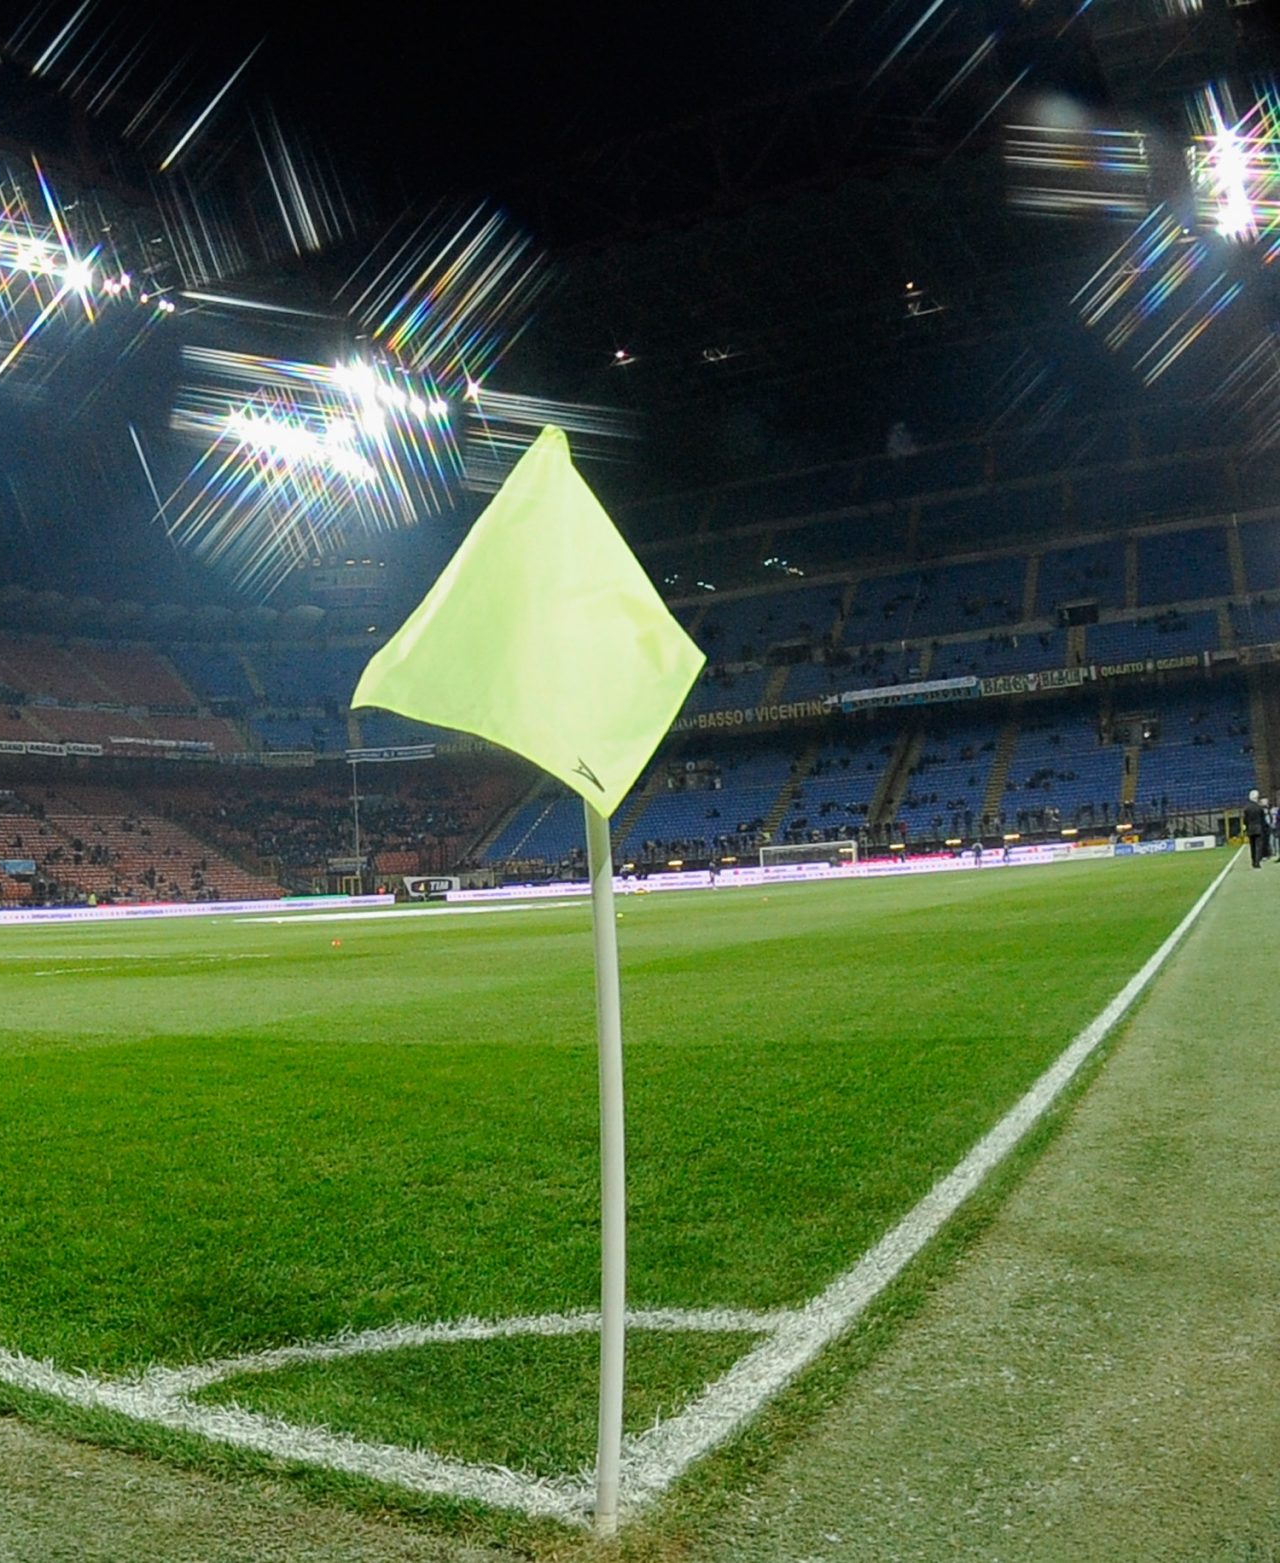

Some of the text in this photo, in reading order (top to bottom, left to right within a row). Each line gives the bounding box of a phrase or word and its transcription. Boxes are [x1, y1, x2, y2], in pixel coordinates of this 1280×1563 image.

[698, 709, 744, 729] BASSO
[754, 700, 833, 722] VICENTINO
[430, 881, 449, 891] TIM
